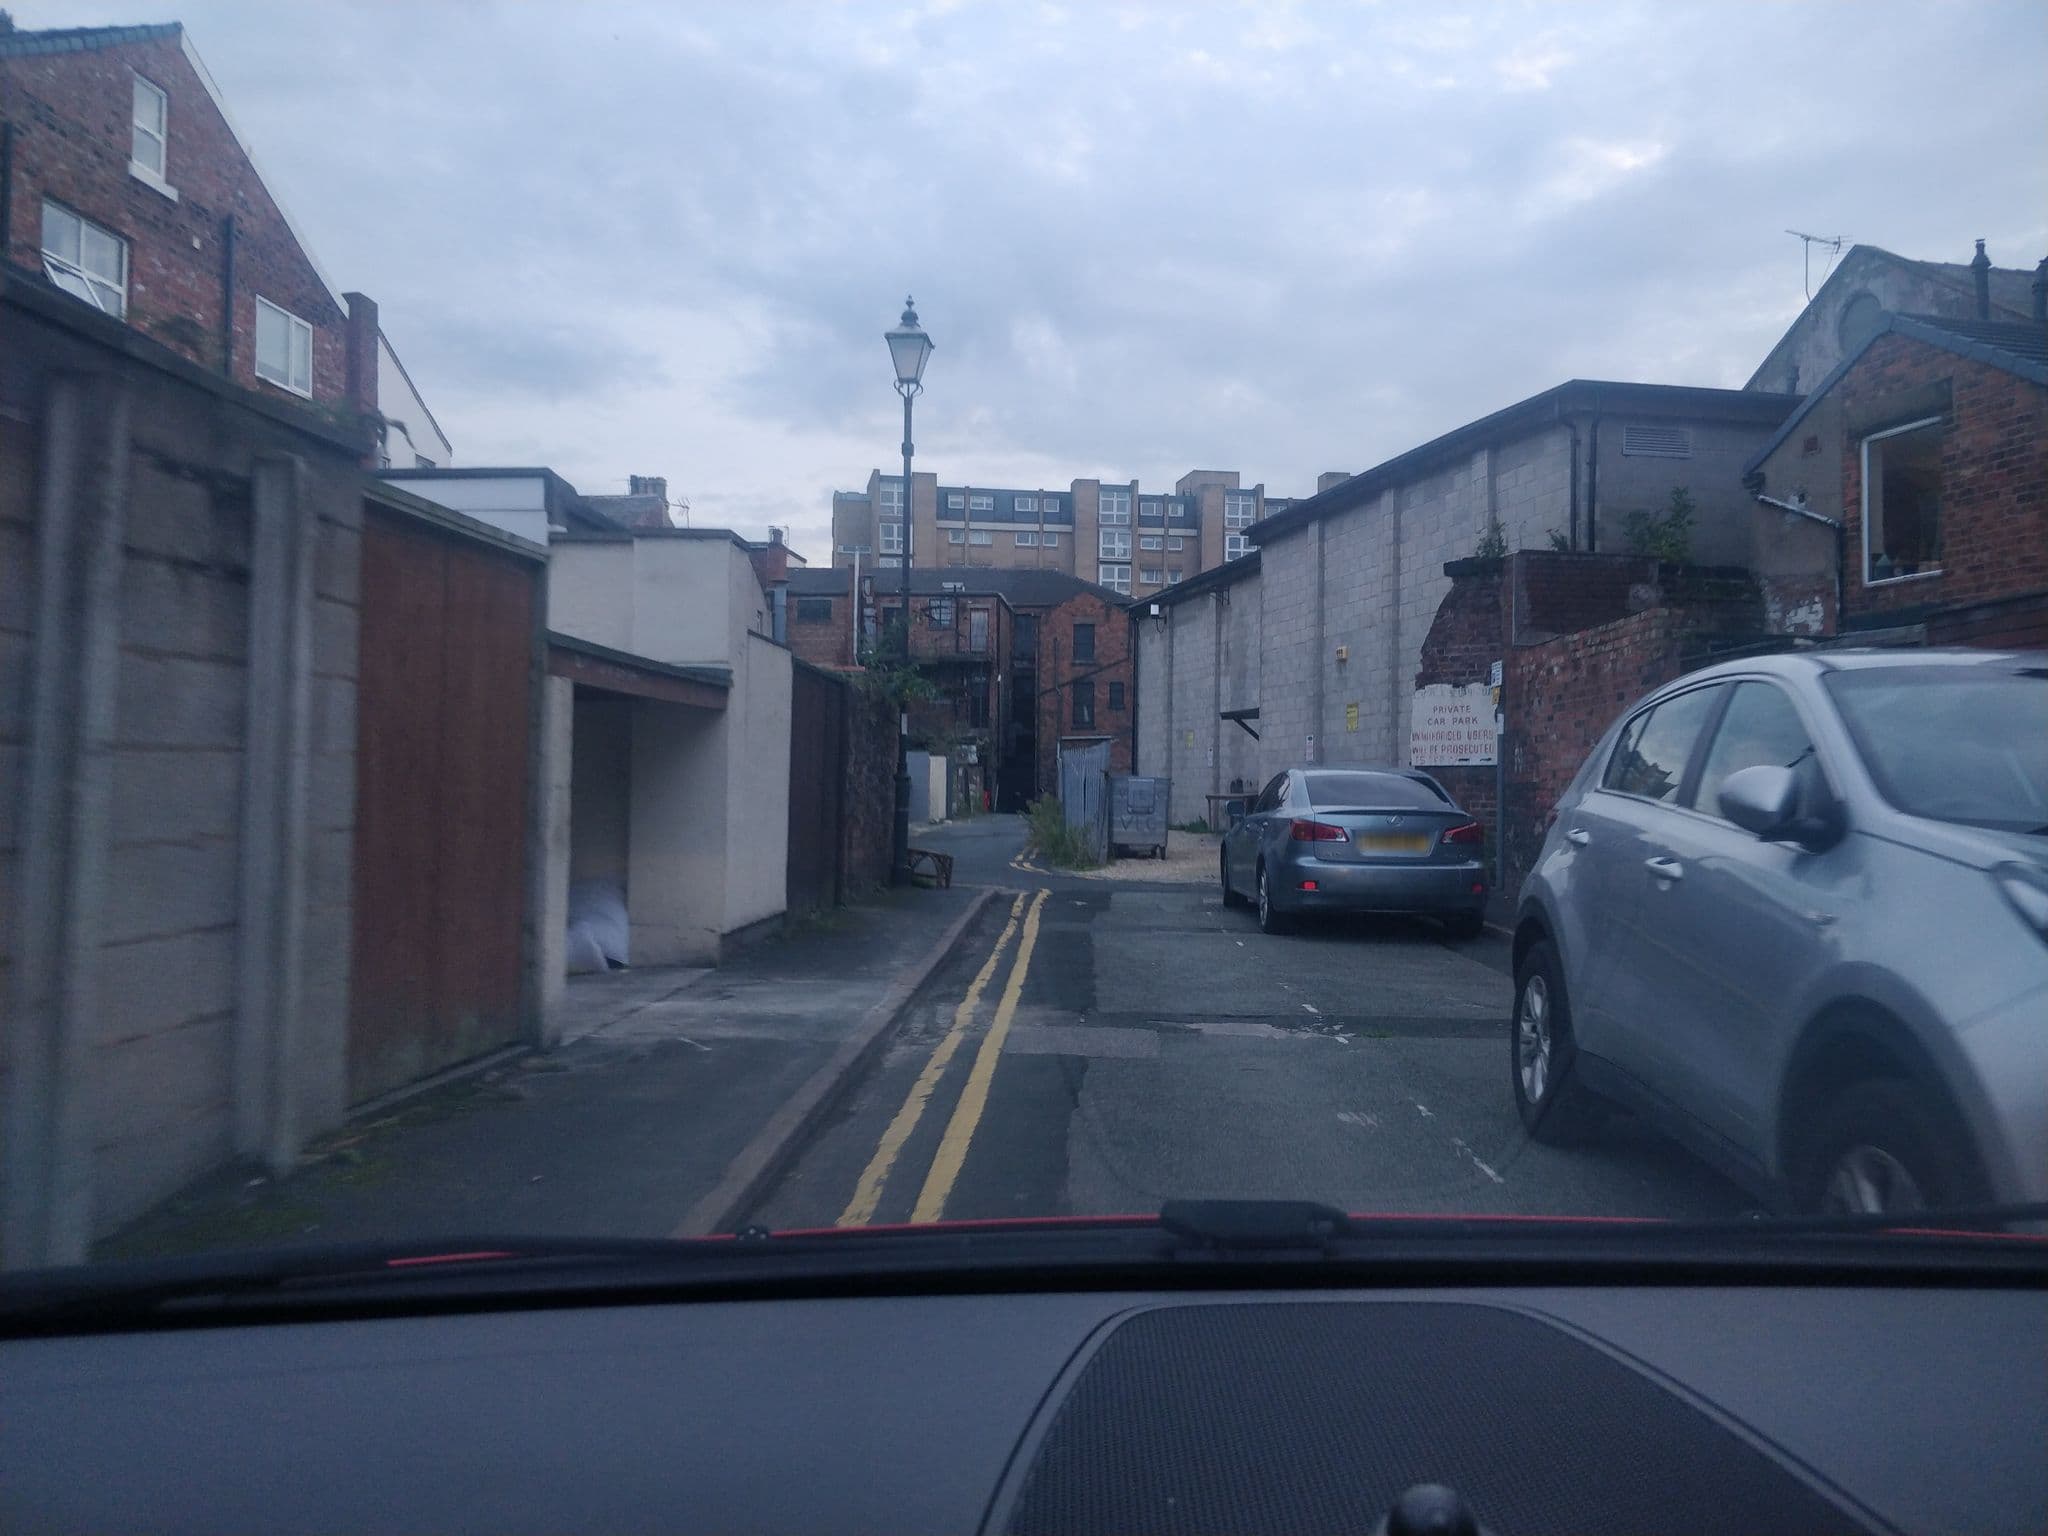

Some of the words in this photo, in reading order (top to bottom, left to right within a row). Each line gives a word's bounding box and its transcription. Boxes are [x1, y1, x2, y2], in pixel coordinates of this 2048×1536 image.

[1433, 705, 1472, 714] PRIVATE
[1427, 717, 1446, 726] CAR
[1452, 716, 1478, 725] PARK
